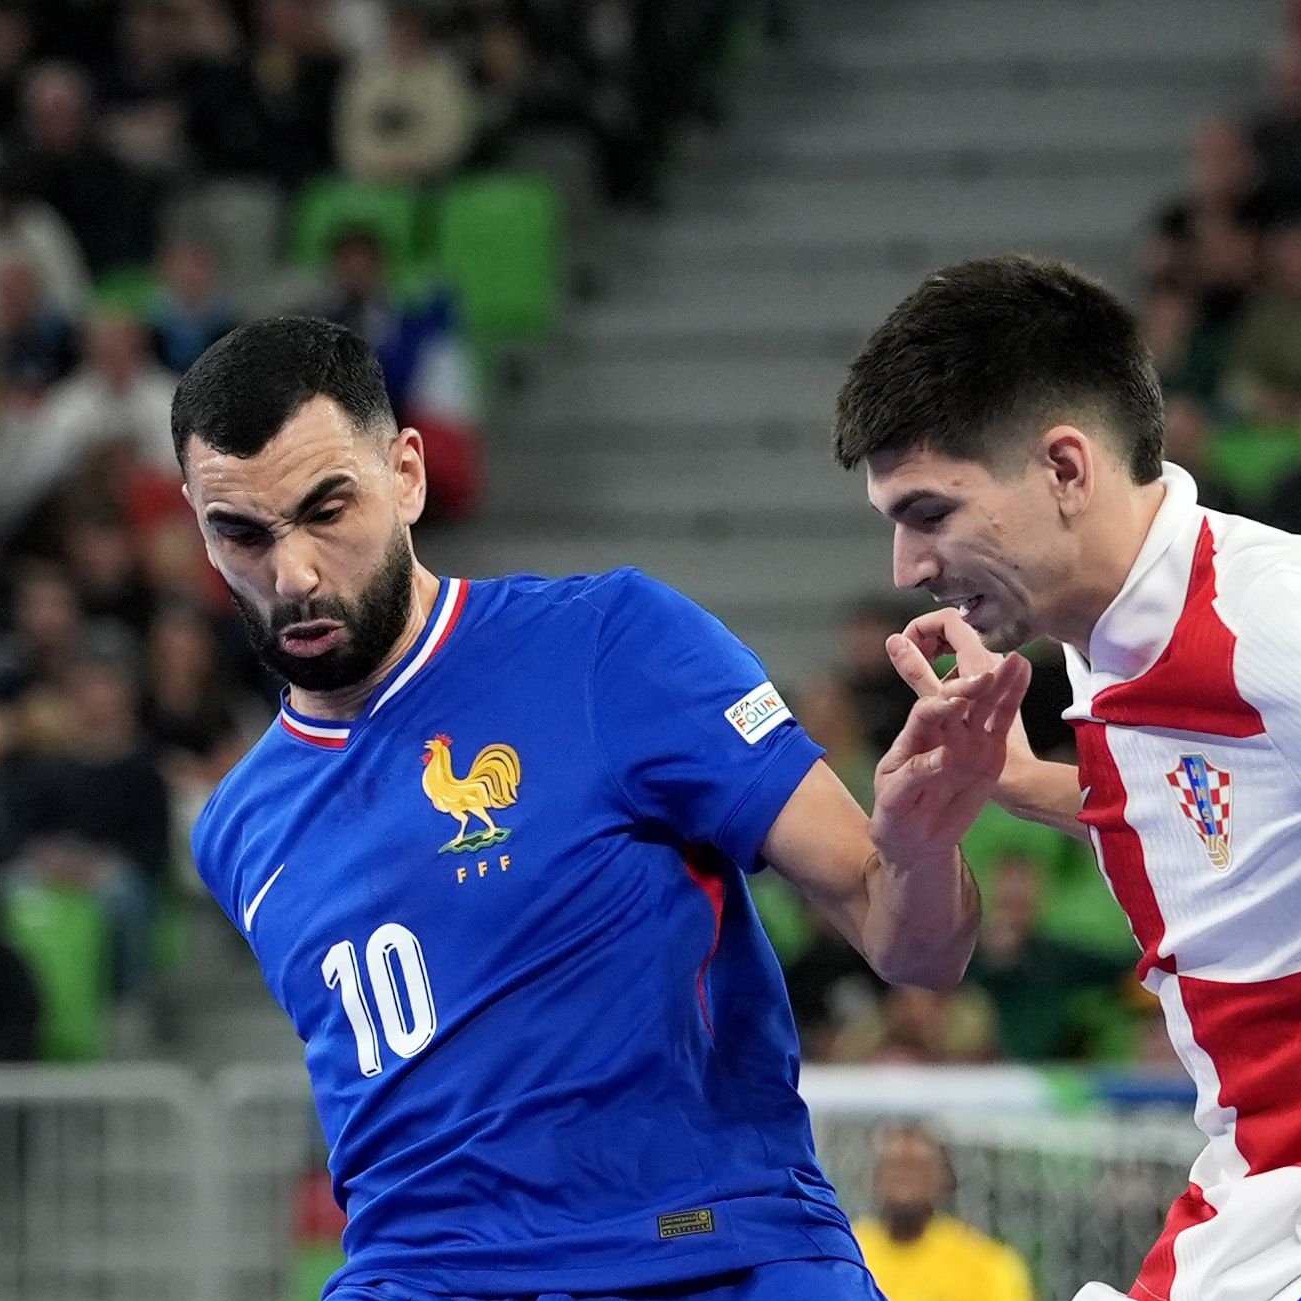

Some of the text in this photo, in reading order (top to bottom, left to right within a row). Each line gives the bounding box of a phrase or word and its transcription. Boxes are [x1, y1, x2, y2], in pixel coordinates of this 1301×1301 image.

[729, 701, 752, 719] UEFA
[735, 695, 780, 731] FOUN
[321, 922, 437, 1078] 10
